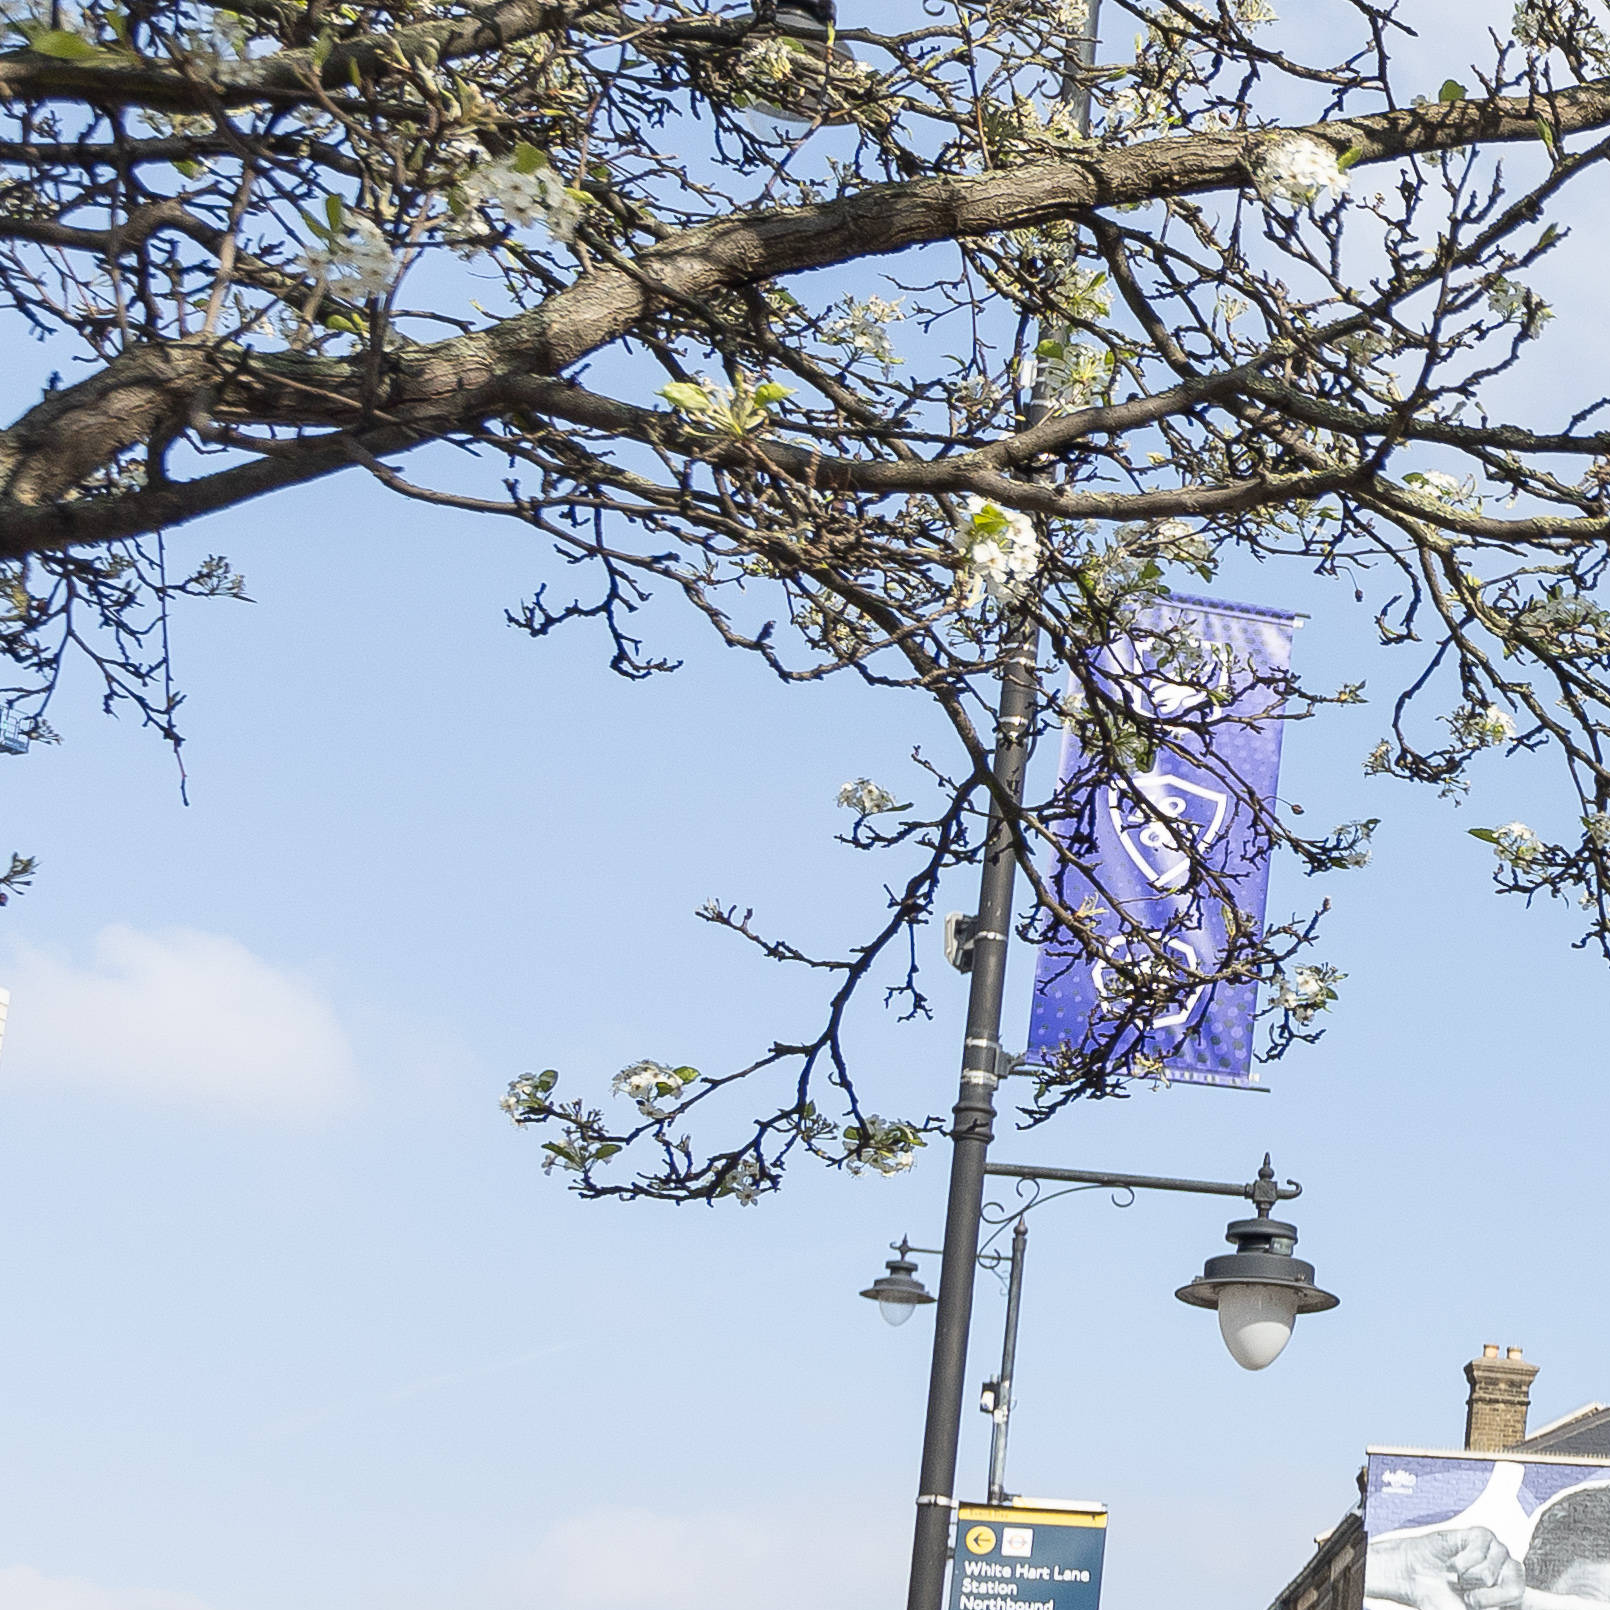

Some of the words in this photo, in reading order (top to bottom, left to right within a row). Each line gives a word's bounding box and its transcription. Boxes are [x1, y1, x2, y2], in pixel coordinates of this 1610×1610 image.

[963, 1559, 1012, 1578] White
[1015, 1563, 1050, 1581] Hart
[1053, 1565, 1091, 1583] Lane
[961, 1577, 1018, 1596] Station
